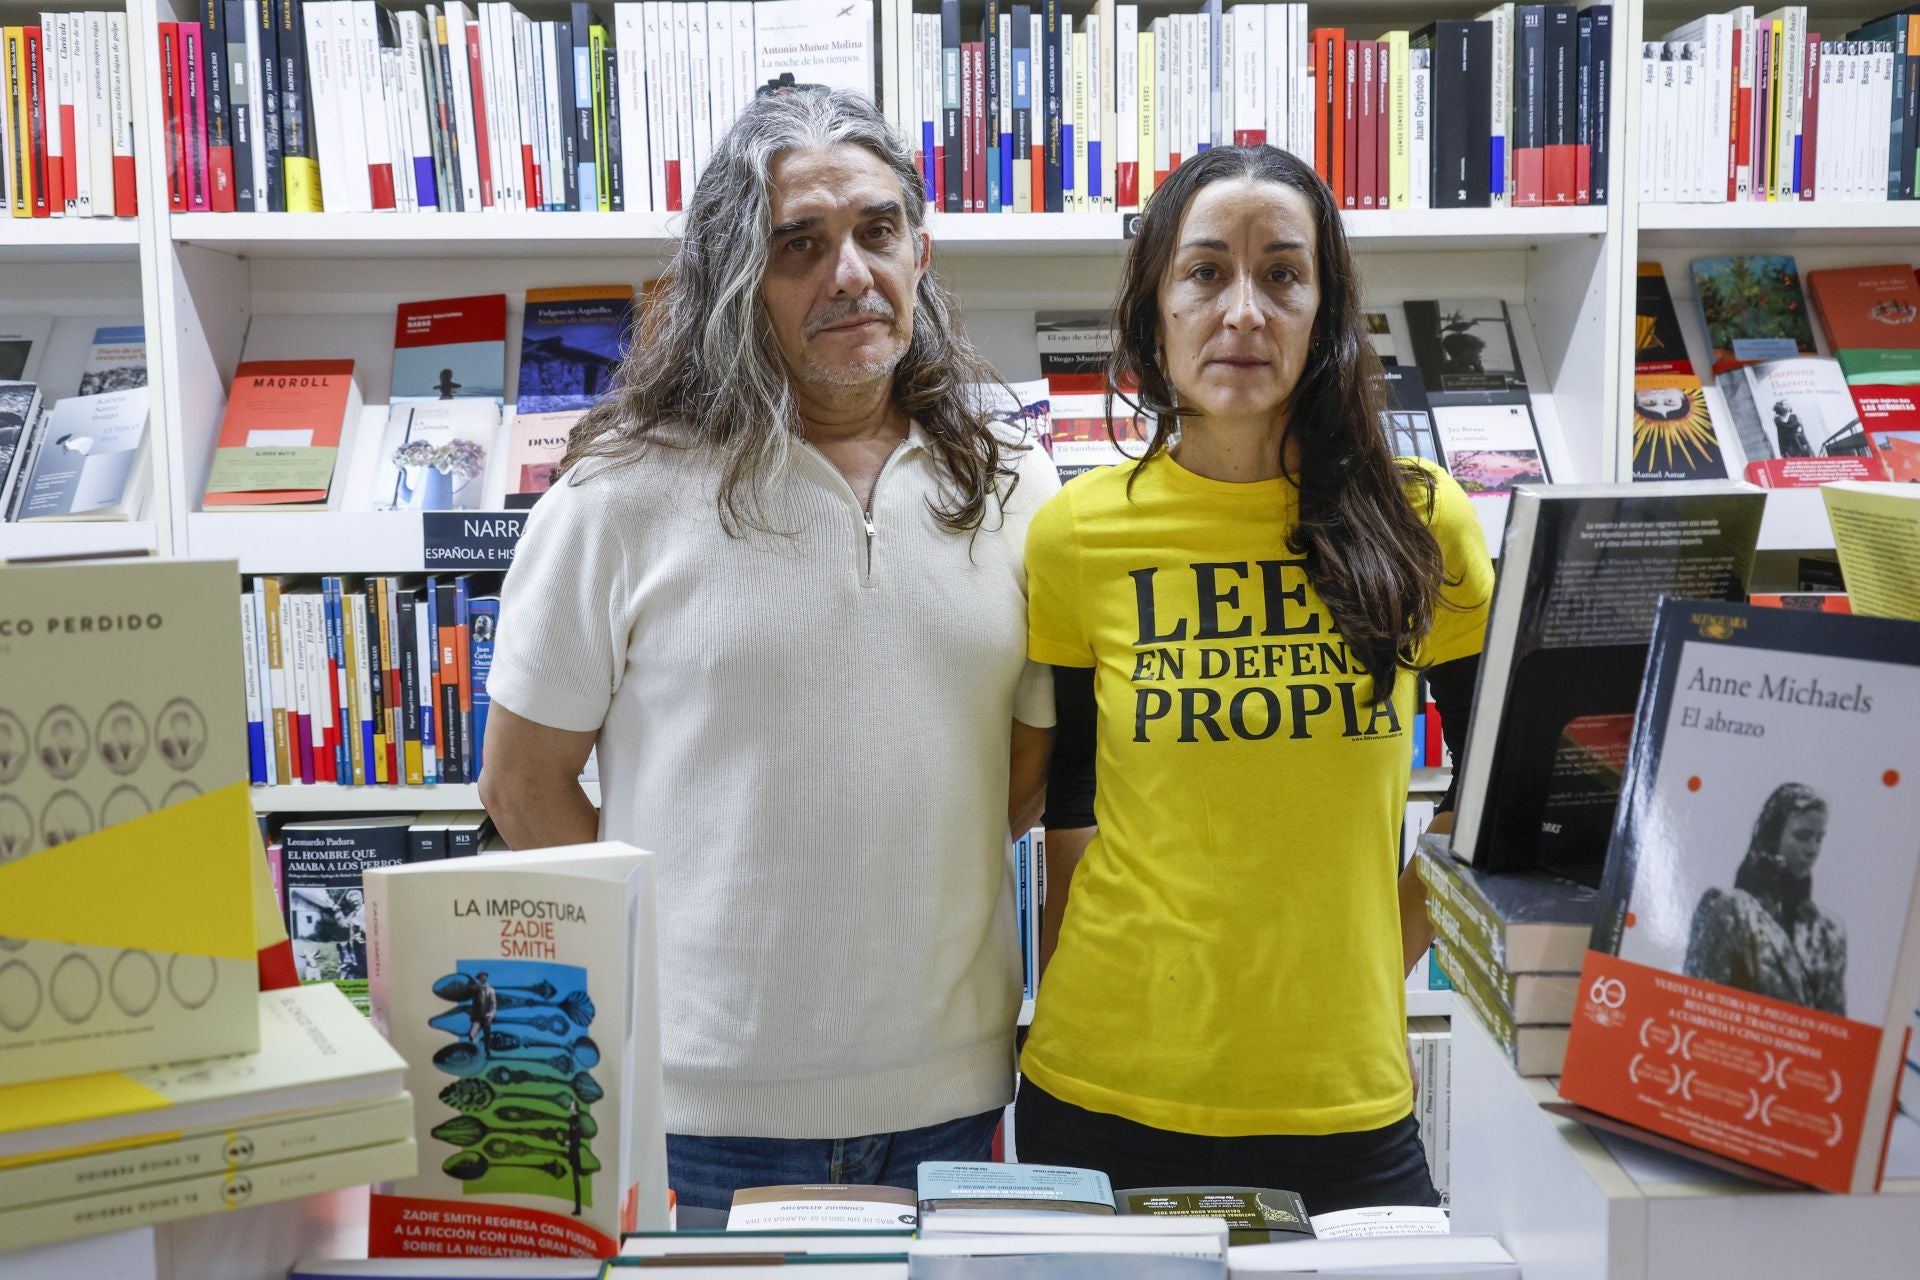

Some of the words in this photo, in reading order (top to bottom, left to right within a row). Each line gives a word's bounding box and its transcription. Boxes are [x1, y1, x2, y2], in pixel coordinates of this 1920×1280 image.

[111, 21, 120, 42] golpe
[1788, 12, 1797, 30] baile
[59, 23, 68, 59] Clavícula
[73, 29, 79, 38] de
[1788, 32, 1796, 42] de
[112, 43, 119, 52] de
[762, 45, 797, 56] Antonio
[799, 43, 829, 53] Muñoz
[831, 39, 862, 51] Molina
[1809, 43, 1817, 67] BAREA
[762, 59, 773, 68] La
[774, 57, 800, 67] noche
[801, 56, 810, 65] de
[812, 55, 824, 65] los
[826, 53, 859, 67] tiempos
[963, 51, 971, 80] GARCÍA
[975, 51, 984, 79] GARCÍA
[1849, 61, 1857, 80] Baroja
[1883, 58, 1893, 80] Baroja
[1645, 64, 1654, 83] Ayala
[1664, 66, 1673, 87] Ayala
[1684, 66, 1693, 85] Ayala
[1823, 60, 1832, 84] Baroja
[1836, 60, 1845, 84] Baroja
[1861, 60, 1870, 85] Baroja
[963, 82, 971, 116] MÁRQUEZ
[975, 80, 984, 118] MÁRQUEZ
[1415, 75, 1426, 117] Goytisolo
[1415, 120, 1424, 141] Juan
[253, 378, 330, 389] MAQROLL
[528, 437, 568, 448] DINOS
[464, 520, 522, 538] NARR
[425, 547, 485, 560] ESPAÑOLA
[488, 549, 494, 560] E
[498, 549, 515, 560] HIS
[1128, 559, 1343, 646] LEE
[48, 613, 164, 634] PERDIDO
[306, 634, 314, 643] El
[1131, 647, 1186, 682] EN
[1200, 642, 1369, 679] DEFEN
[1686, 666, 1752, 698] Anne
[1758, 673, 1874, 714] Michaels
[1132, 682, 1402, 743] PROPIA
[1680, 706, 1700, 729] El
[1704, 710, 1766, 738] abrazo
[287, 838, 325, 846] Leonardo
[326, 838, 355, 846] Padura
[288, 851, 301, 860] EL
[303, 850, 350, 860] HOMBRE
[351, 849, 376, 861] QUE
[288, 862, 325, 871] AMABA
[328, 862, 335, 871] A
[337, 862, 358, 871] LOS
[454, 899, 481, 918] LA
[486, 898, 586, 924] IMPOSTURA
[500, 920, 555, 940] ZADIE
[500, 940, 556, 959] SMITH
[1589, 976, 1627, 1009] 60
[1684, 999, 1742, 1023] BESTSELLER
[1745, 1014, 1810, 1041] TRADUCIDO
[394, 1224, 403, 1234] A
[407, 1225, 421, 1236] LA
[425, 1226, 475, 1240] FICCIÓN
[480, 1231, 506, 1243] CON
[510, 1234, 535, 1246] UNA
[538, 1237, 568, 1253] GRAN
[402, 1210, 440, 1222] ZADIE
[443, 1213, 481, 1225] SMITH
[485, 1213, 538, 1232] REGRESA
[540, 1223, 564, 1236] CON
[566, 1229, 597, 1251] FUERZA
[403, 1240, 443, 1253] SOBRE
[447, 1243, 461, 1254] LA
